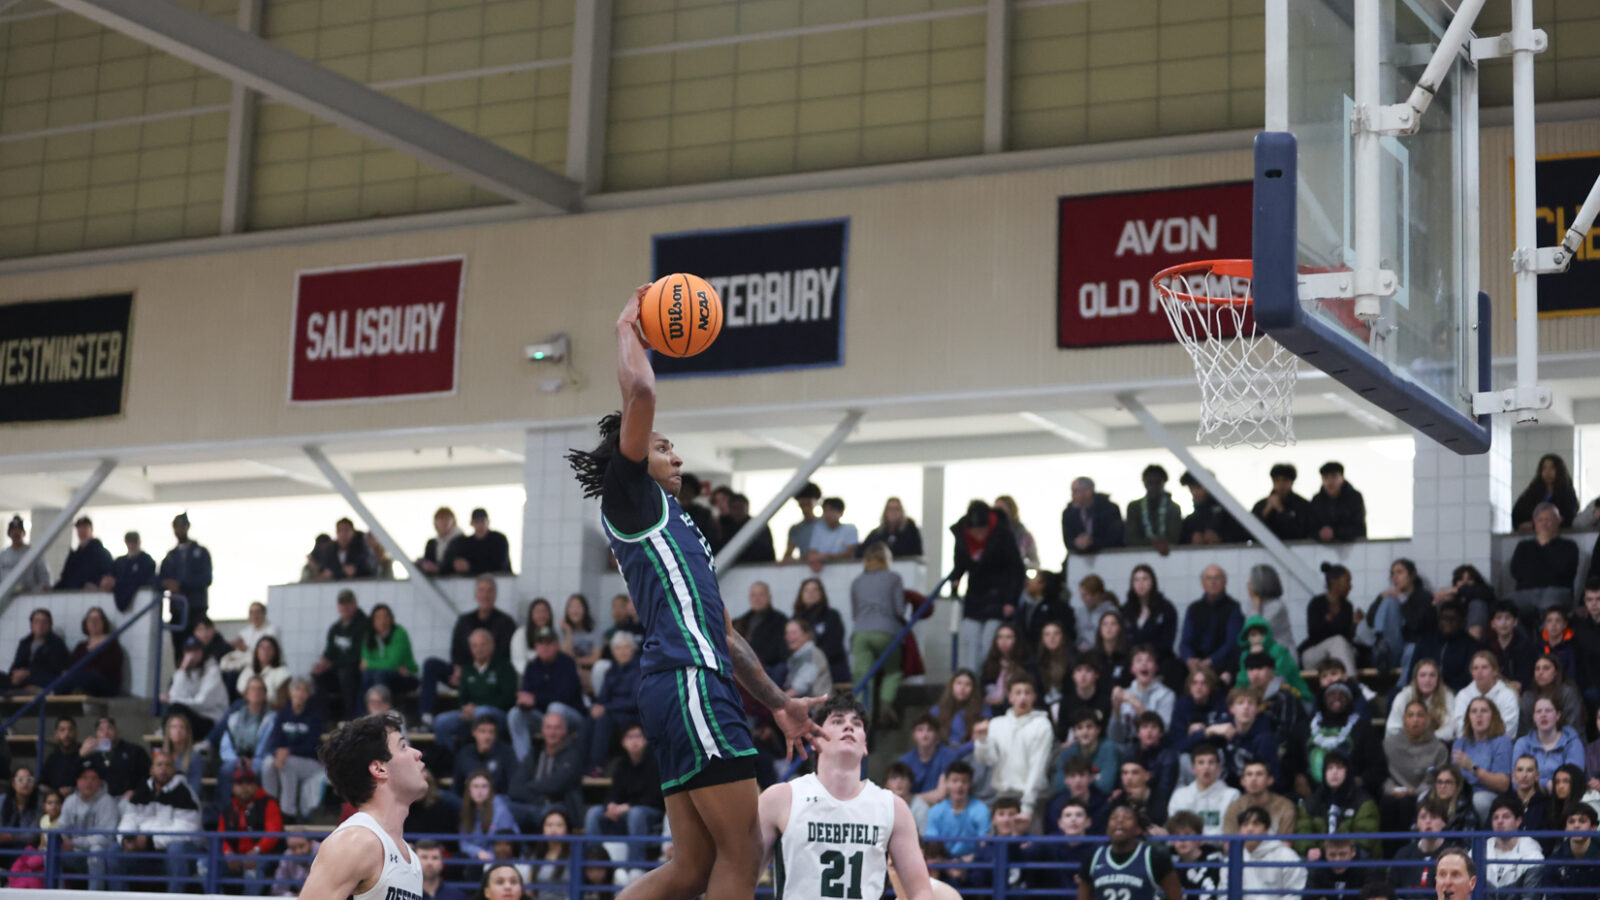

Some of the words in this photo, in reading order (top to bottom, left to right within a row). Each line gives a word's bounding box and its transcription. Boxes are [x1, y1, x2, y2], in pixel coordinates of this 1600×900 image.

[1115, 214, 1217, 257] AVON
[668, 284, 684, 340] Wilson
[697, 291, 709, 331] NCAA
[704, 266, 840, 328] TERBURY
[1079, 279, 1140, 318] OLD
[306, 302, 445, 360] SALISBURY
[807, 821, 879, 846] DEERFIELD
[820, 850, 864, 899] 21
